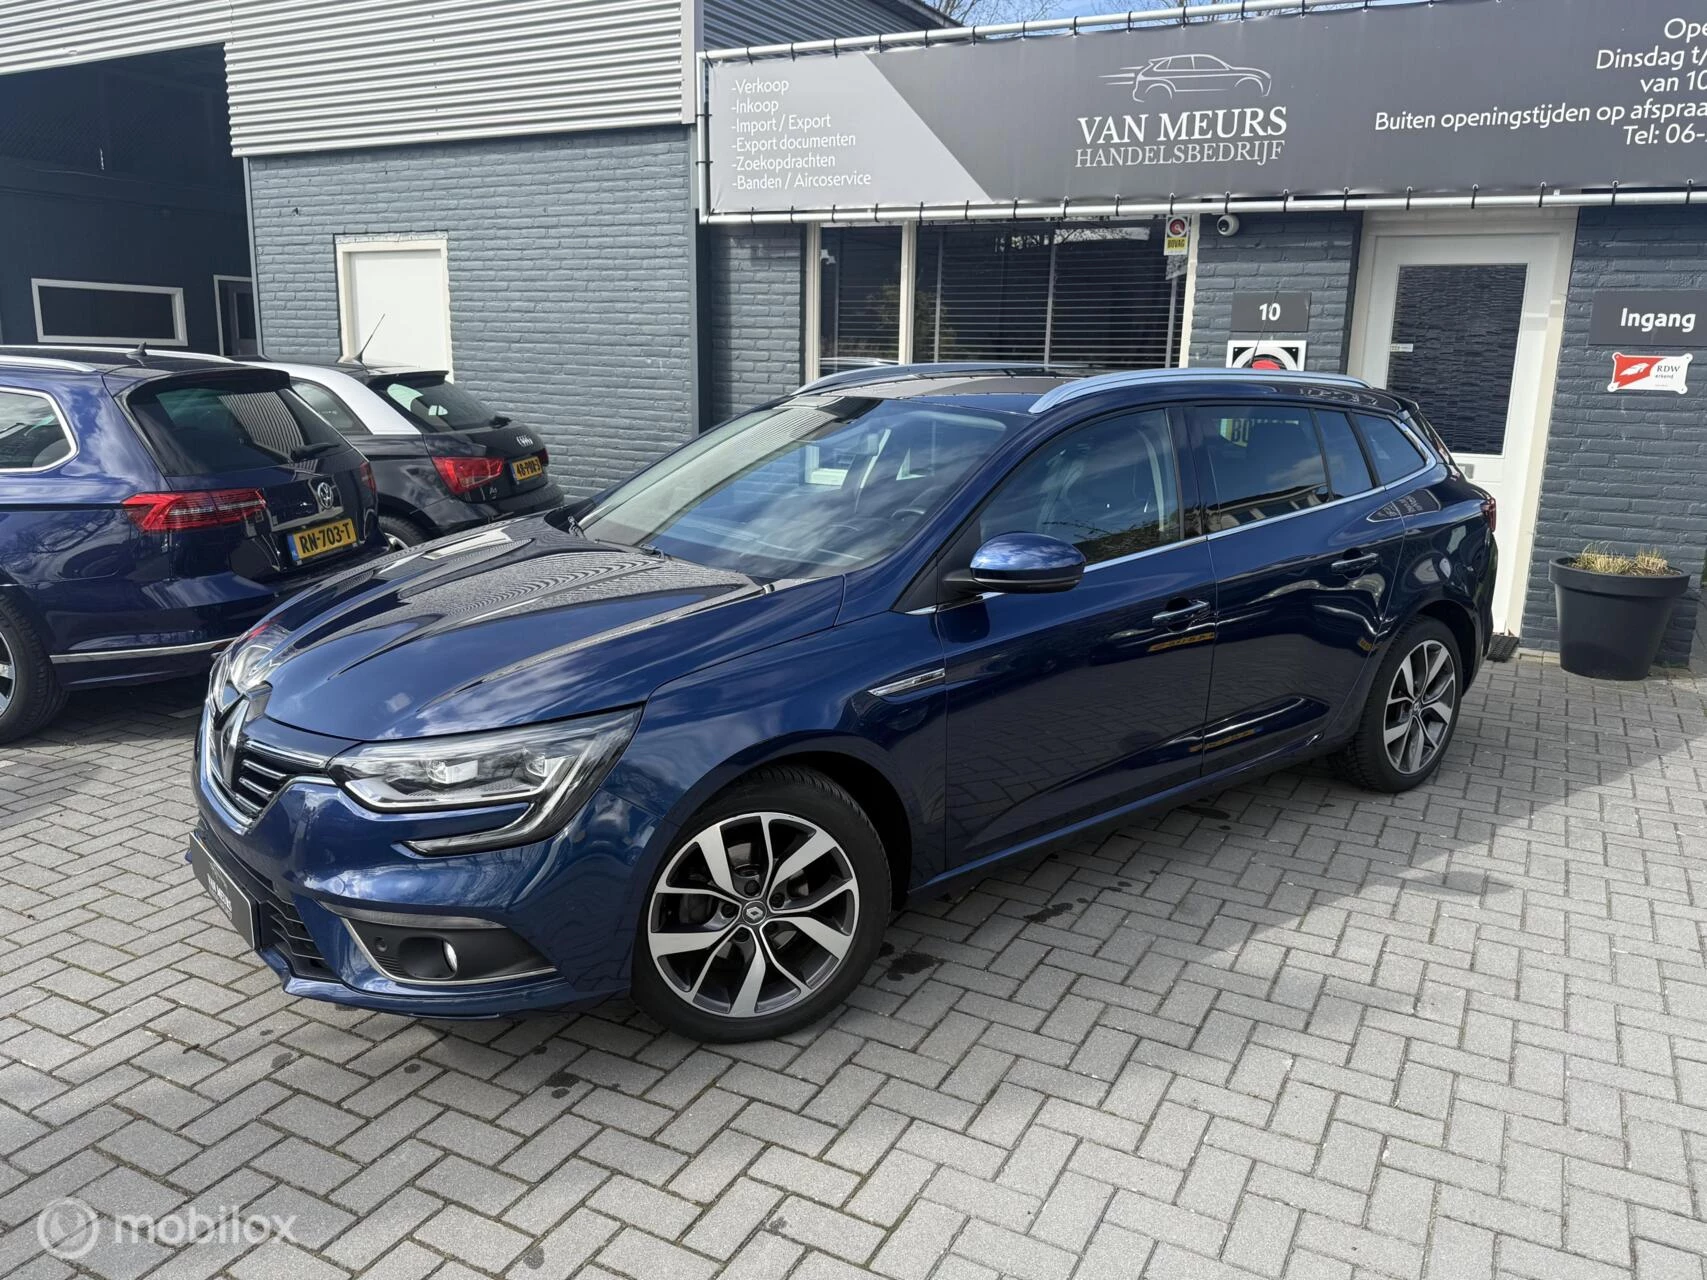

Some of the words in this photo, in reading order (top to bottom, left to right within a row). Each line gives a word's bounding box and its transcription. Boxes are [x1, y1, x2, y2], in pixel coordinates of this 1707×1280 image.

[1596, 45, 1685, 70] Dinsdag
[731, 77, 790, 96] -Verkoop
[1640, 77, 1680, 93] van
[1686, 70, 1707, 91] 10
[731, 97, 779, 115] -Inkoop
[1375, 111, 1436, 130] Buiten
[1441, 102, 1591, 132] openingstijden
[1596, 105, 1625, 126] op
[731, 117, 778, 136] -Import
[788, 113, 832, 133] Export
[1077, 113, 1149, 145] VAN
[1157, 106, 1288, 141] MEURS
[1623, 124, 1660, 145] Tel:
[1665, 123, 1707, 144] 06-
[731, 136, 777, 155] -Export
[779, 133, 857, 150] documenten
[1075, 140, 1286, 168] HANDELSBEDRIJF
[731, 152, 836, 173] -Zoekopdrachten
[731, 173, 782, 190] -Banden
[793, 170, 872, 188] Aircoservice
[1259, 303, 1281, 321] 10
[1620, 307, 1697, 333] Ingang
[1656, 364, 1681, 373] RDW
[299, 522, 351, 554] RN-703-T
